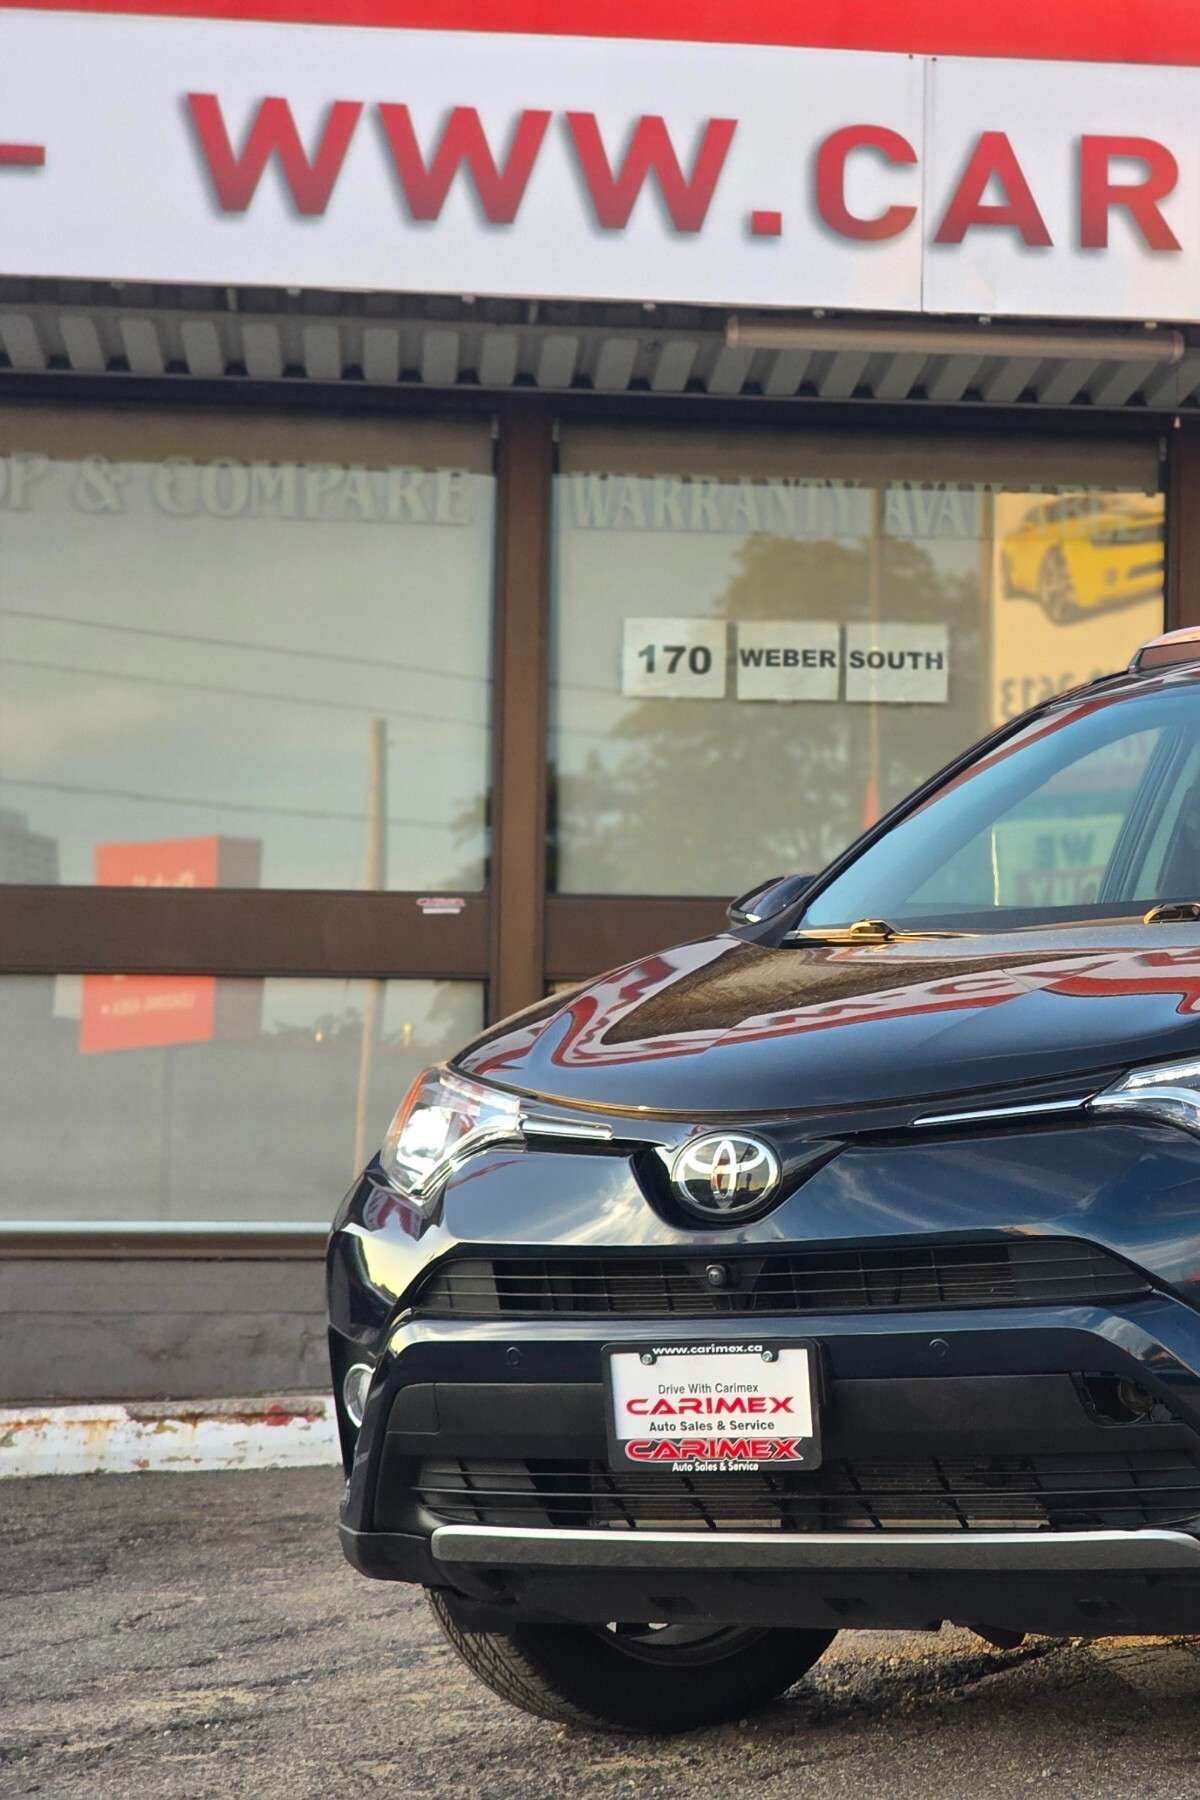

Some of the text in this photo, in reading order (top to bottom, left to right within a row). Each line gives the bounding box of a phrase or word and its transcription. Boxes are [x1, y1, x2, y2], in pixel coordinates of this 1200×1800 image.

[73, 454, 127, 515] &
[152, 456, 475, 525] COMPARE
[570, 471, 870, 537] WARRANTY
[638, 644, 944, 675] 170 WEBER SOUTH
[652, 1343, 763, 1355] www.carimex.ca
[658, 1382, 759, 1395] Drive With Carimex
[626, 1396, 795, 1416] CARIMEX
[649, 1420, 775, 1432] Auto Sales & Service
[625, 1438, 804, 1462] CARIMEX
[672, 1461, 759, 1473] Auto Sales & Service
